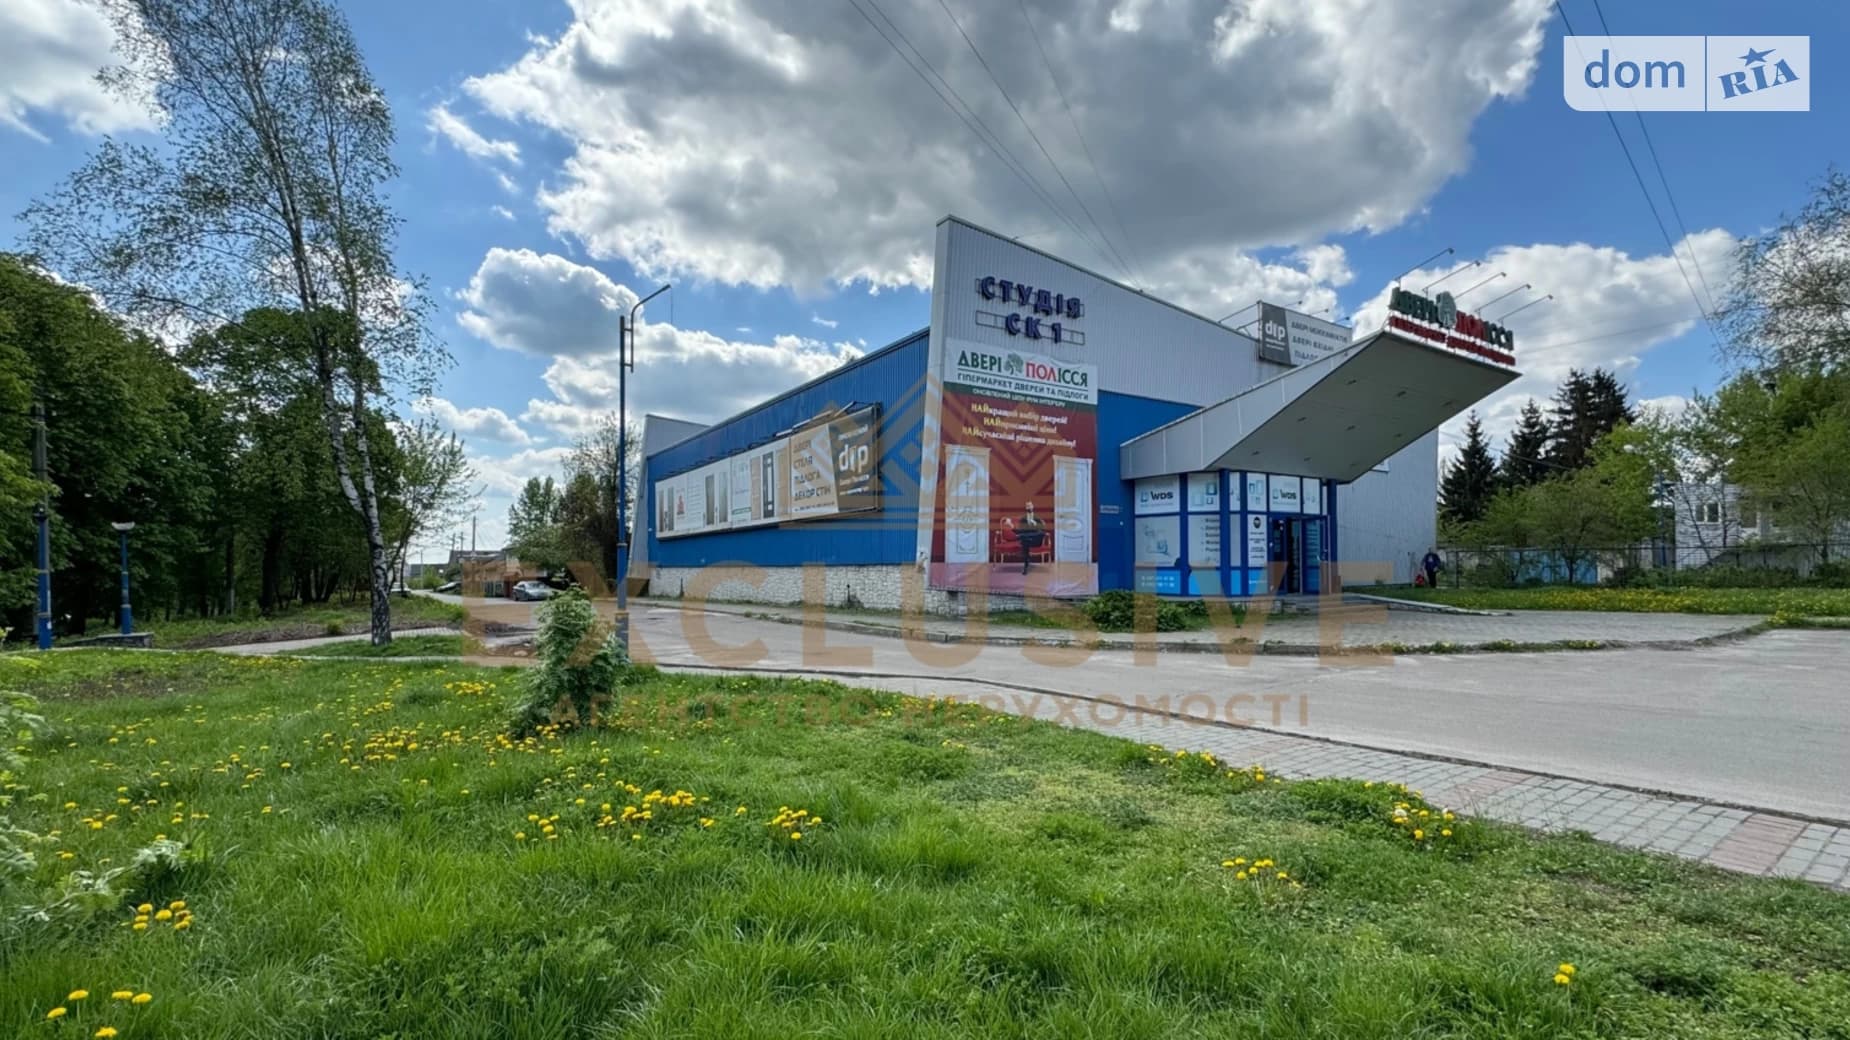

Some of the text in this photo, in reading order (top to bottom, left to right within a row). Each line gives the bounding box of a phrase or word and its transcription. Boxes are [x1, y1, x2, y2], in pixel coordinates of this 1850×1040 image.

[981, 275, 1081, 319] СТУДІЯ
[1005, 313, 1062, 343] СК 1
[957, 350, 1088, 387] ДВЕРІ ПОЛІССЯ
[957, 373, 1088, 401] ГІПЕРМАРКЕТ ДВЕРЕЙ ТА ПІДЛОГИ
[1150, 491, 1174, 501] WDS
